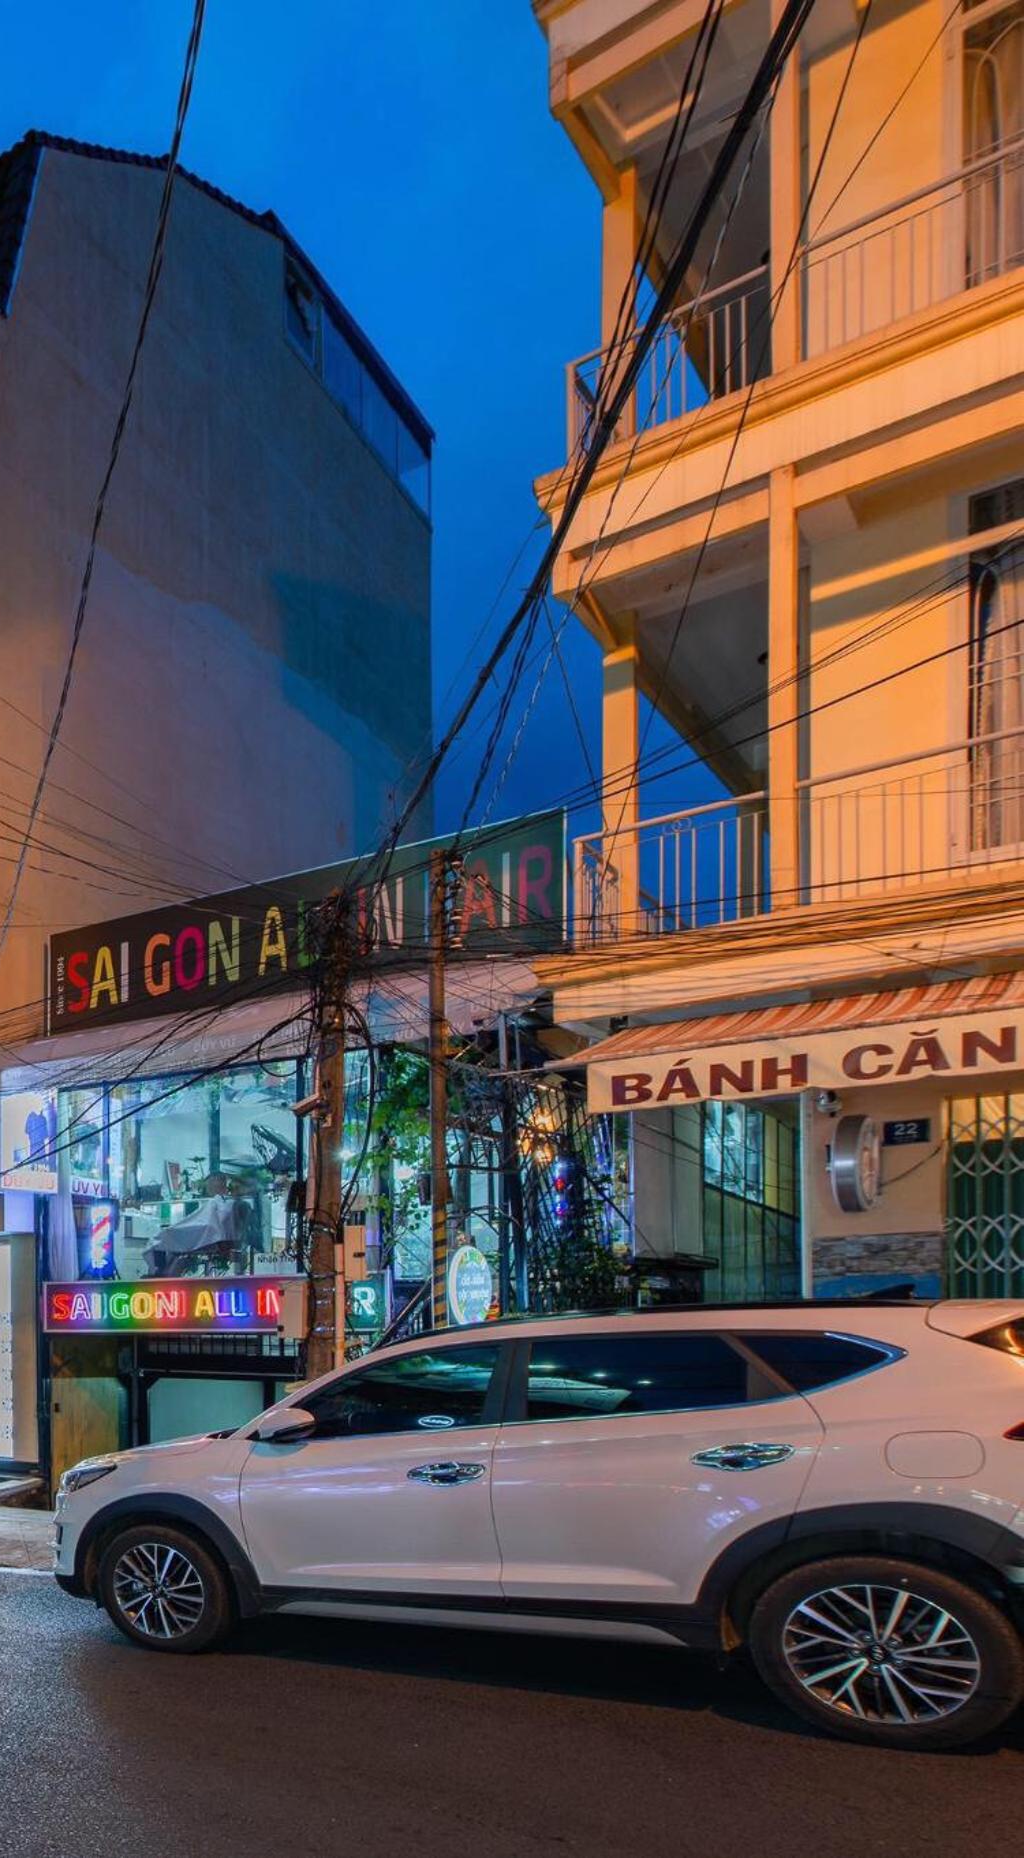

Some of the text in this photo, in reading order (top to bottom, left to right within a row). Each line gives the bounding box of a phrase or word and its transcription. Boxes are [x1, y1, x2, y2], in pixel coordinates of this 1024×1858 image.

[55, 955, 65, 980] 1994
[611, 1027, 1017, 1106] BÁNH CĂN
[893, 1123, 919, 1136] 22
[195, 1290, 250, 1318] ALL
